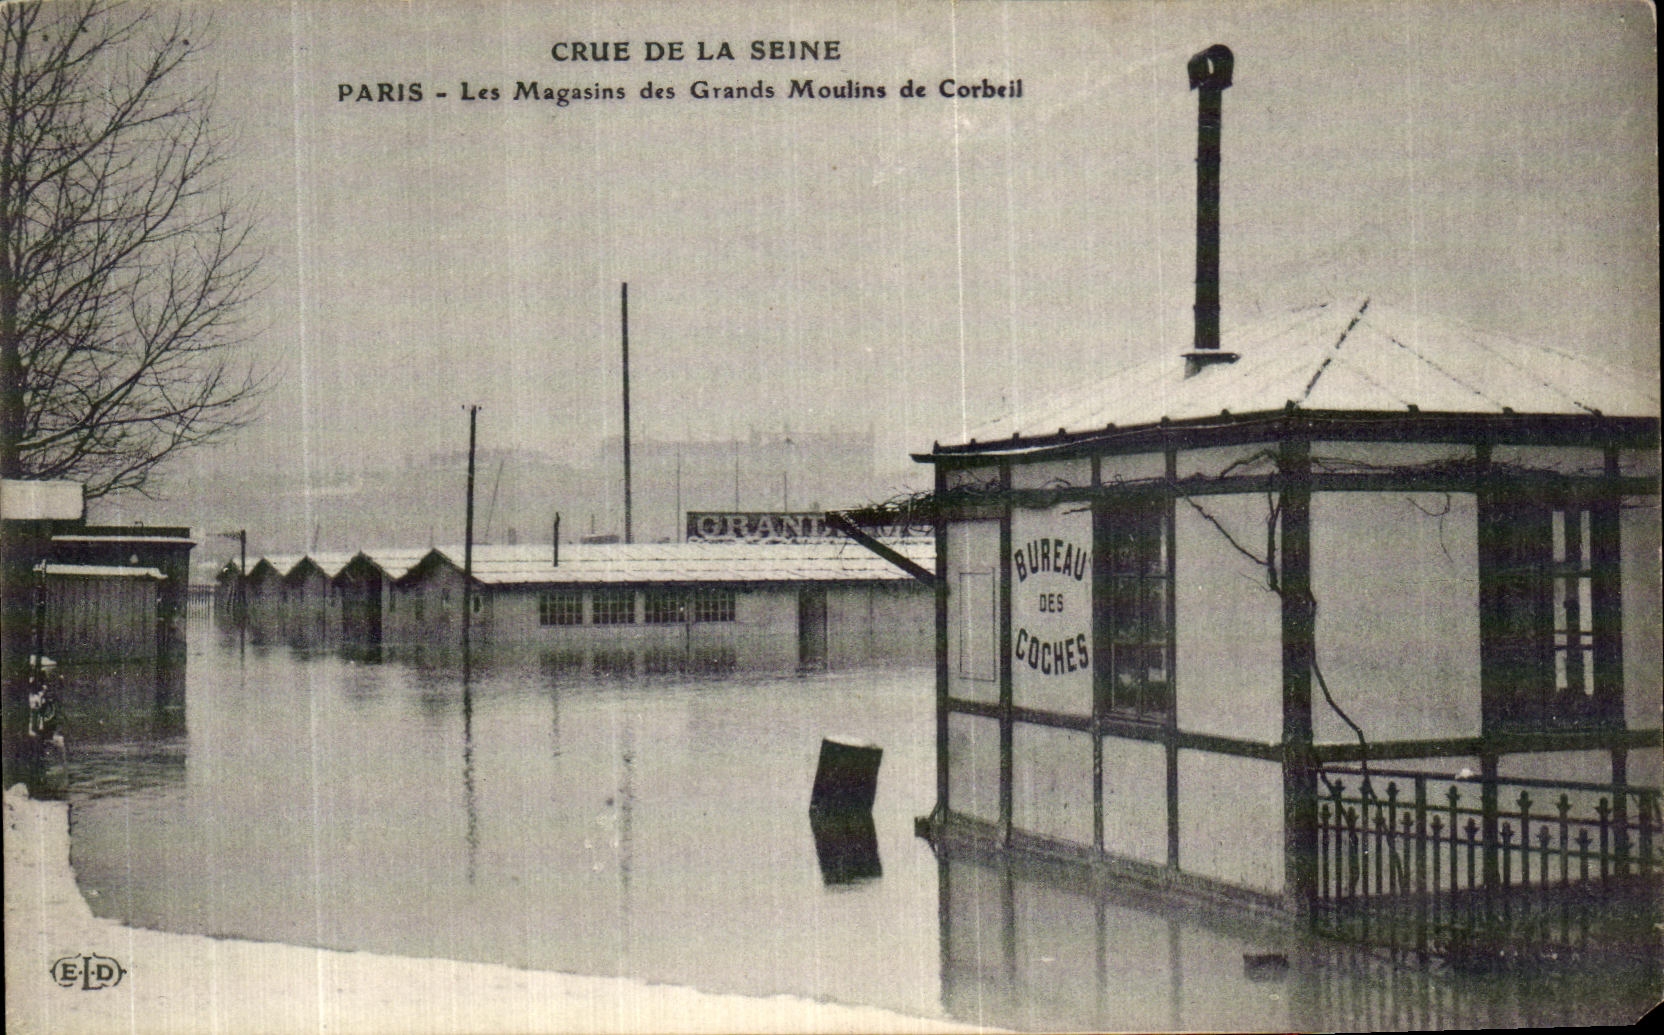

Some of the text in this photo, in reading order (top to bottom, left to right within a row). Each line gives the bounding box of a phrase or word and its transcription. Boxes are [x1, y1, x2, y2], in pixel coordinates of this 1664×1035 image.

[696, 513, 850, 539] GRAND
[1014, 538, 1087, 583] BUREAU
[1039, 593, 1064, 613] DES
[1016, 628, 1089, 675] COCHES
